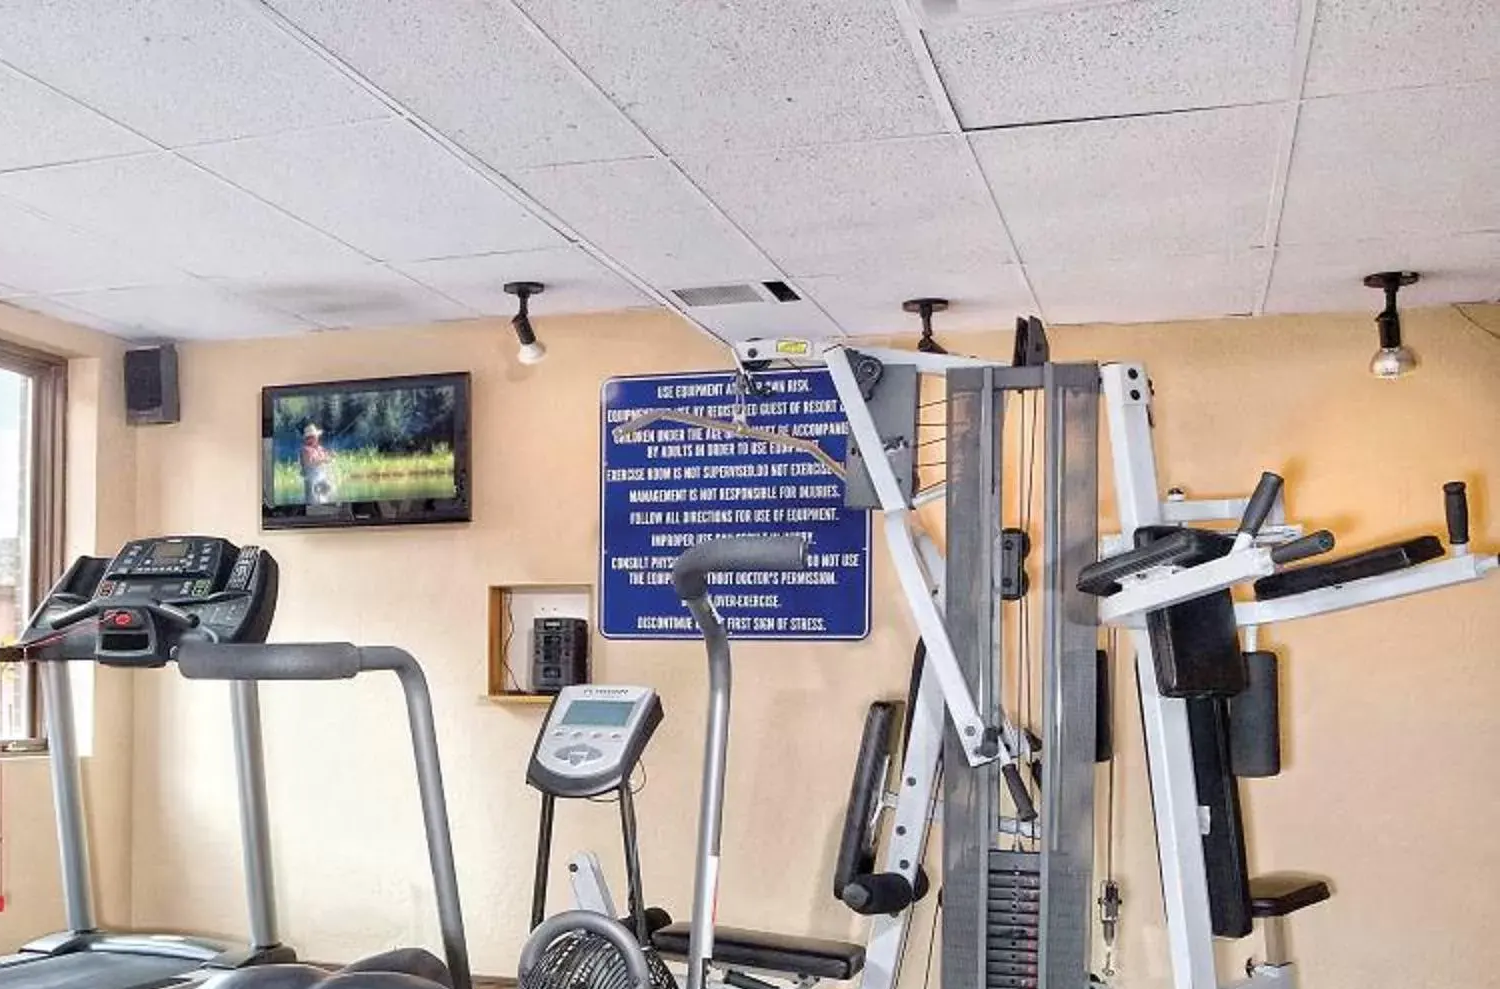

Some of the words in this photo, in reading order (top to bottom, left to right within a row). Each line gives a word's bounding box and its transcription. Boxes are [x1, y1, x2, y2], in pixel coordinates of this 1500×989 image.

[657, 385, 674, 399] USE
[675, 383, 723, 398] EQUIPMENT
[607, 408, 650, 422] EQUIPM
[706, 402, 757, 419] REGISED
[759, 401, 788, 416] GUEST
[790, 401, 801, 415] OF
[803, 399, 837, 414] RESORT
[657, 429, 685, 442] UNDER
[687, 427, 703, 441] THE
[646, 445, 659, 458] BY
[661, 443, 693, 458] ADULTS
[695, 443, 705, 457] IN
[707, 442, 735, 457] ORDER
[737, 441, 749, 455] TO
[751, 441, 768, 455] USE
[607, 467, 645, 481] EXERCISE
[647, 467, 671, 480] ROOM
[673, 466, 683, 479] IS
[684, 466, 701, 480] NOT
[771, 463, 789, 477] NOT
[629, 488, 688, 503] MANAGEMENT
[689, 488, 699, 501] IS
[700, 487, 718, 501] NOT
[719, 486, 778, 501] RESPONSIBLE
[780, 485, 797, 499] FOR
[799, 485, 841, 498] INJURIES.
[630, 511, 663, 525] FOLLOW
[665, 511, 680, 524] ALL
[683, 509, 733, 524] DIRECTIONS
[735, 509, 753, 523] FOR
[754, 508, 771, 522] USE
[773, 508, 785, 521] OF
[787, 507, 840, 521] EQUIPMENT.
[651, 533, 695, 547] IMPROPER
[611, 556, 649, 570] CONSULT
[807, 554, 819, 568] DO
[821, 553, 841, 567] NOT
[842, 553, 860, 567] USE
[629, 571, 645, 585] THE
[735, 571, 779, 585] DOCTOR'S
[781, 571, 838, 585] PERMISSION.
[637, 615, 693, 629] DISCONTINUE
[727, 617, 751, 631] FIRST
[753, 617, 775, 631] SIGN
[777, 617, 788, 630] OF
[790, 617, 827, 631] STRESS.
